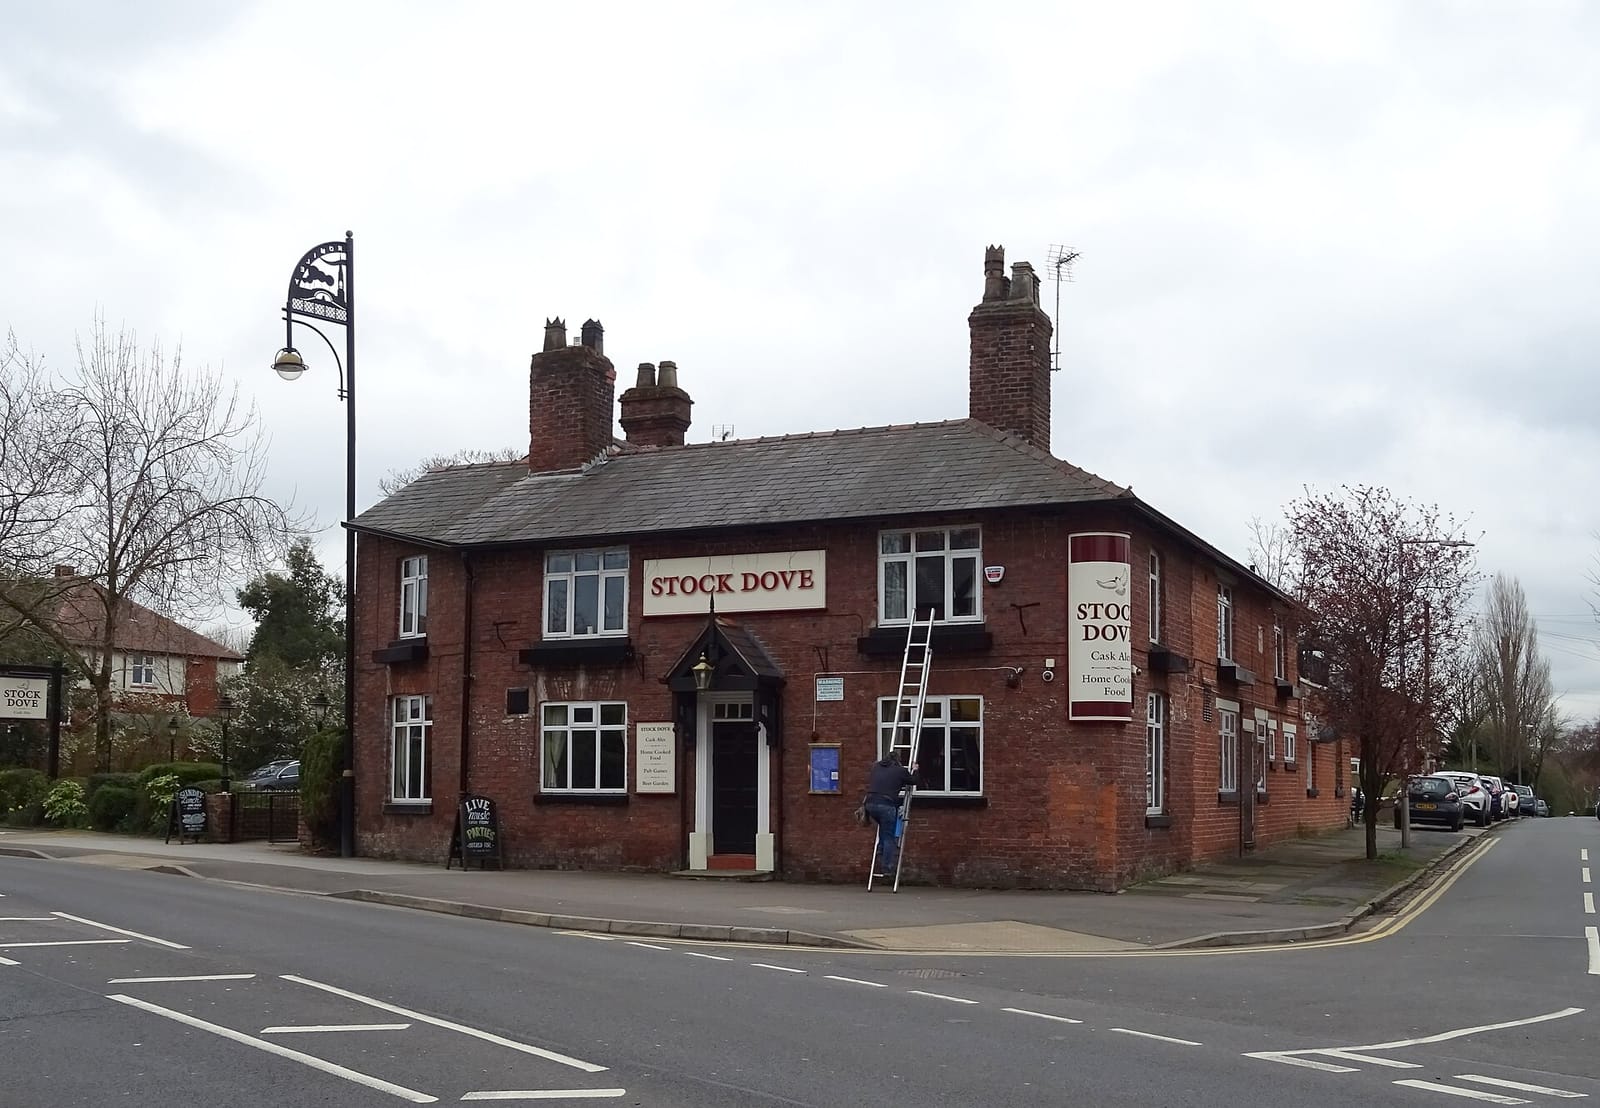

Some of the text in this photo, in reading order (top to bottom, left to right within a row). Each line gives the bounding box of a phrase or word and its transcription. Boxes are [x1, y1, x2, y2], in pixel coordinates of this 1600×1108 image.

[651, 569, 814, 596] STOCK DOVE
[1077, 603, 1130, 621] STOC
[1082, 624, 1130, 642] DOV
[1091, 651, 1130, 661] Cask Ale
[1082, 674, 1111, 683] Home
[4, 689, 41, 699] STOCK
[1104, 687, 1126, 696] Food
[8, 699, 38, 708] DOVE
[465, 799, 490, 813] LIVE
[468, 810, 490, 820] music
[466, 826, 495, 840] PARTIES
